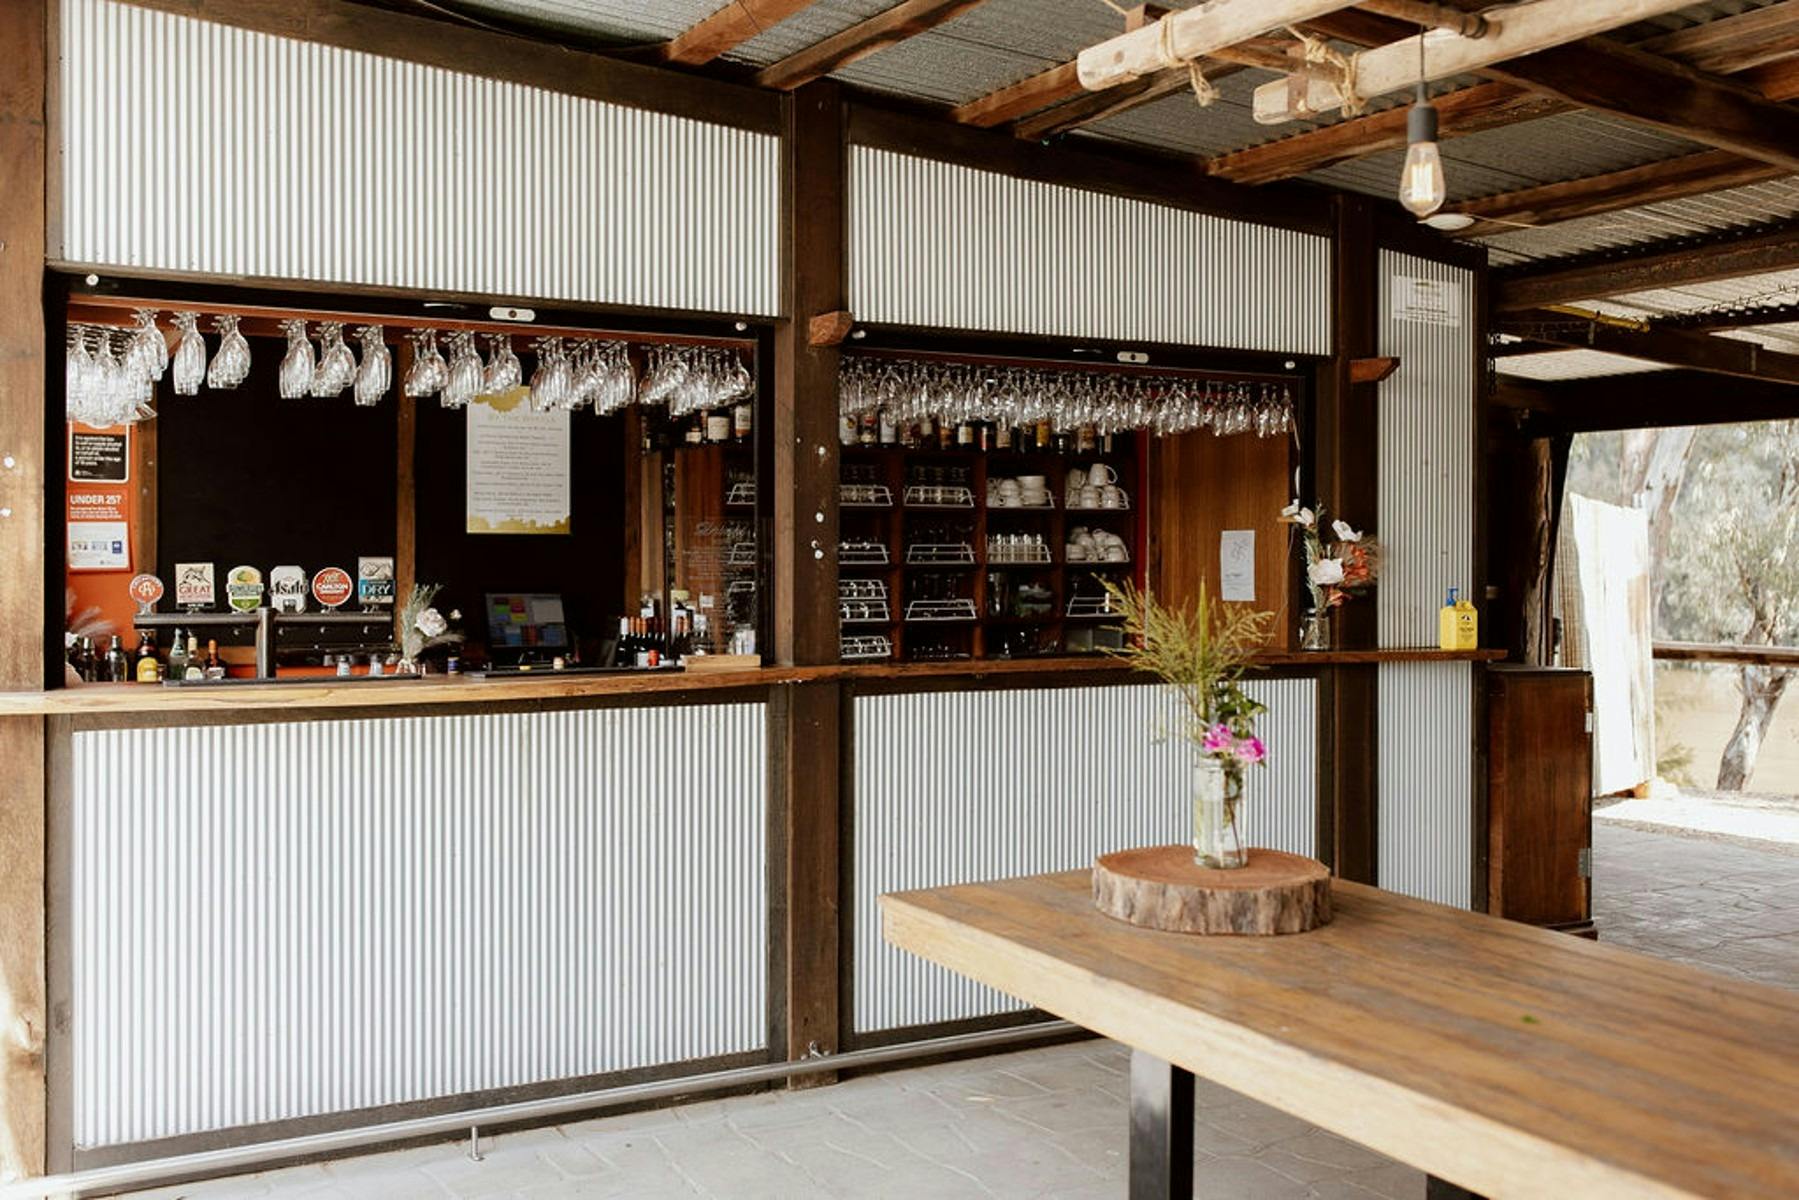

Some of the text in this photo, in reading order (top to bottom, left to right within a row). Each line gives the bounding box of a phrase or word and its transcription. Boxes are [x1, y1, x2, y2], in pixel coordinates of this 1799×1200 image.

[70, 495, 104, 505] UNDER
[179, 584, 211, 594] GREAT
[362, 584, 391, 595] DRY
